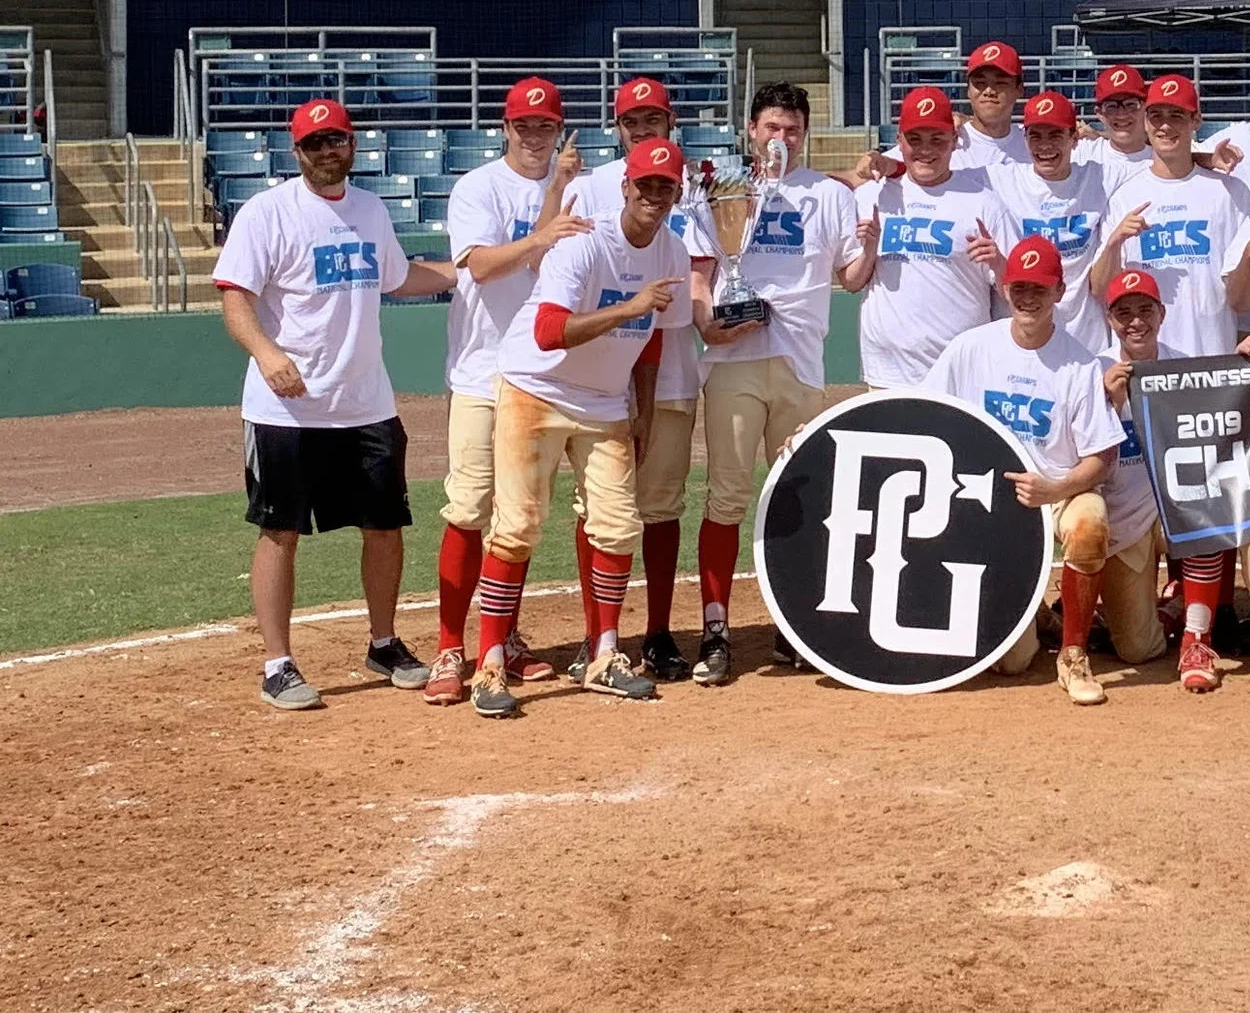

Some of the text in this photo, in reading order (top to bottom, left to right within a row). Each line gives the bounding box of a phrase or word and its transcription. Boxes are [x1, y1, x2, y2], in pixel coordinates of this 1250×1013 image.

[982, 45, 1001, 62] D
[1110, 70, 1128, 87] D
[1160, 80, 1179, 97] D
[526, 87, 546, 106] D
[632, 82, 652, 101] D
[308, 104, 330, 124] D
[916, 97, 936, 117] D
[1035, 98, 1054, 116] D
[649, 147, 671, 165] D
[752, 211, 804, 246] CS
[881, 217, 955, 256] BCS
[1140, 220, 1210, 260] BCS
[313, 241, 379, 285] BCS
[1020, 250, 1040, 270] D
[1121, 272, 1141, 290] D
[984, 390, 1055, 437] BCS
[1176, 410, 1243, 440] 2019
[815, 428, 996, 658] PG
